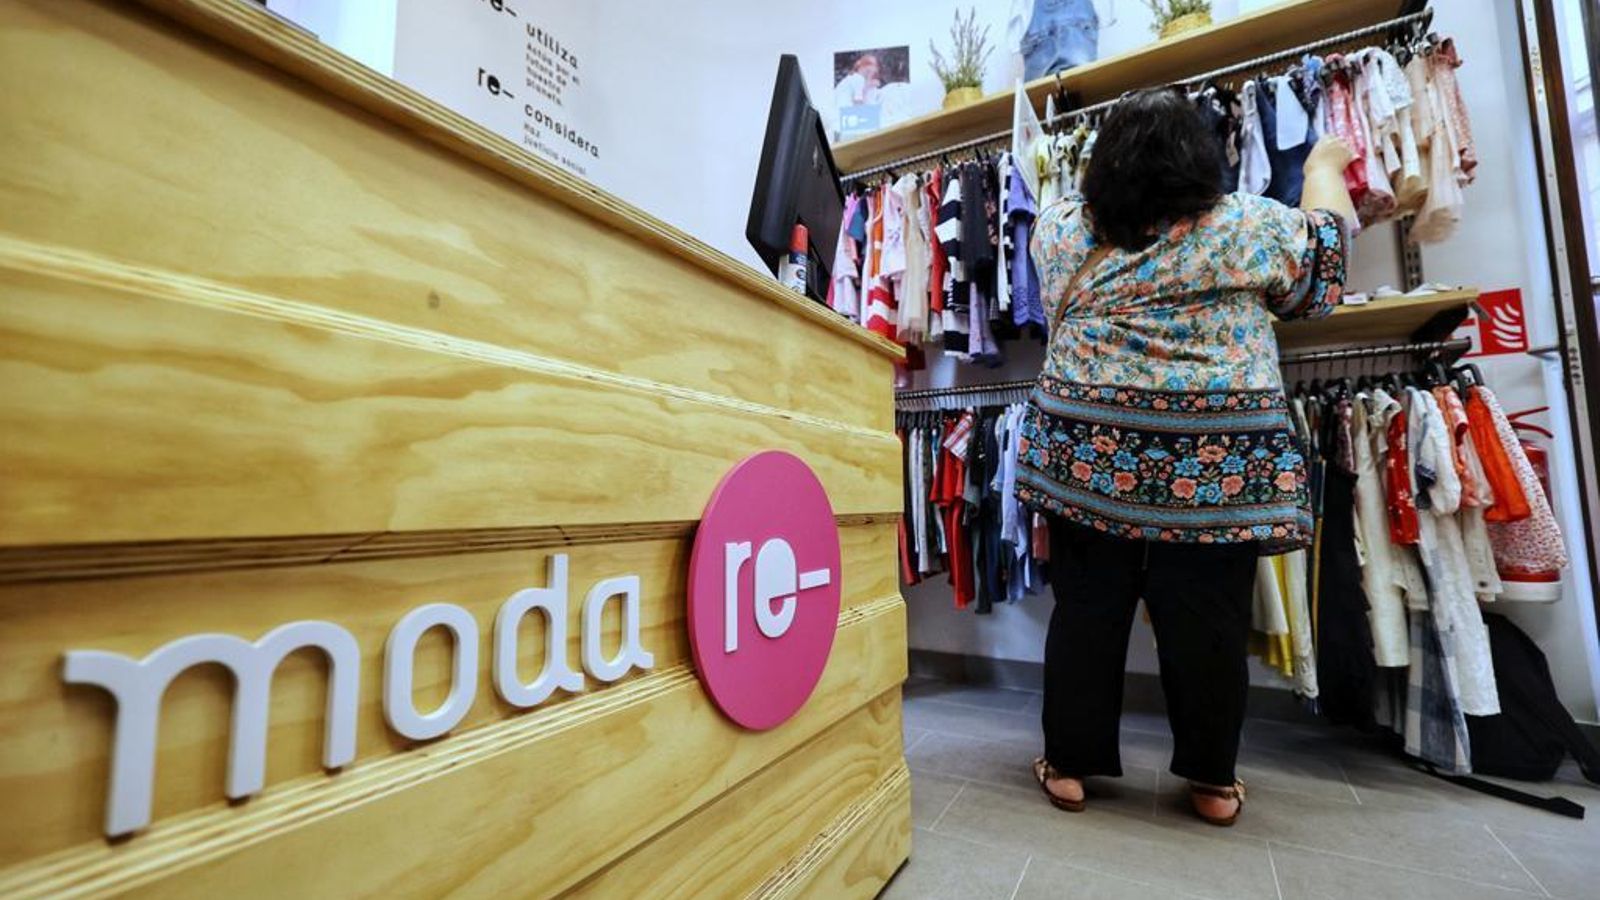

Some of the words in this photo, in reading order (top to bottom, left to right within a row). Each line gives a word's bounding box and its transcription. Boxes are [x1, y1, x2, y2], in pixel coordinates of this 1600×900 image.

[526, 23, 578, 69] utiliza
[478, 67, 515, 99] re-
[524, 104, 599, 159] considera
[63, 553, 655, 837] moda
[725, 537, 830, 653] re-
